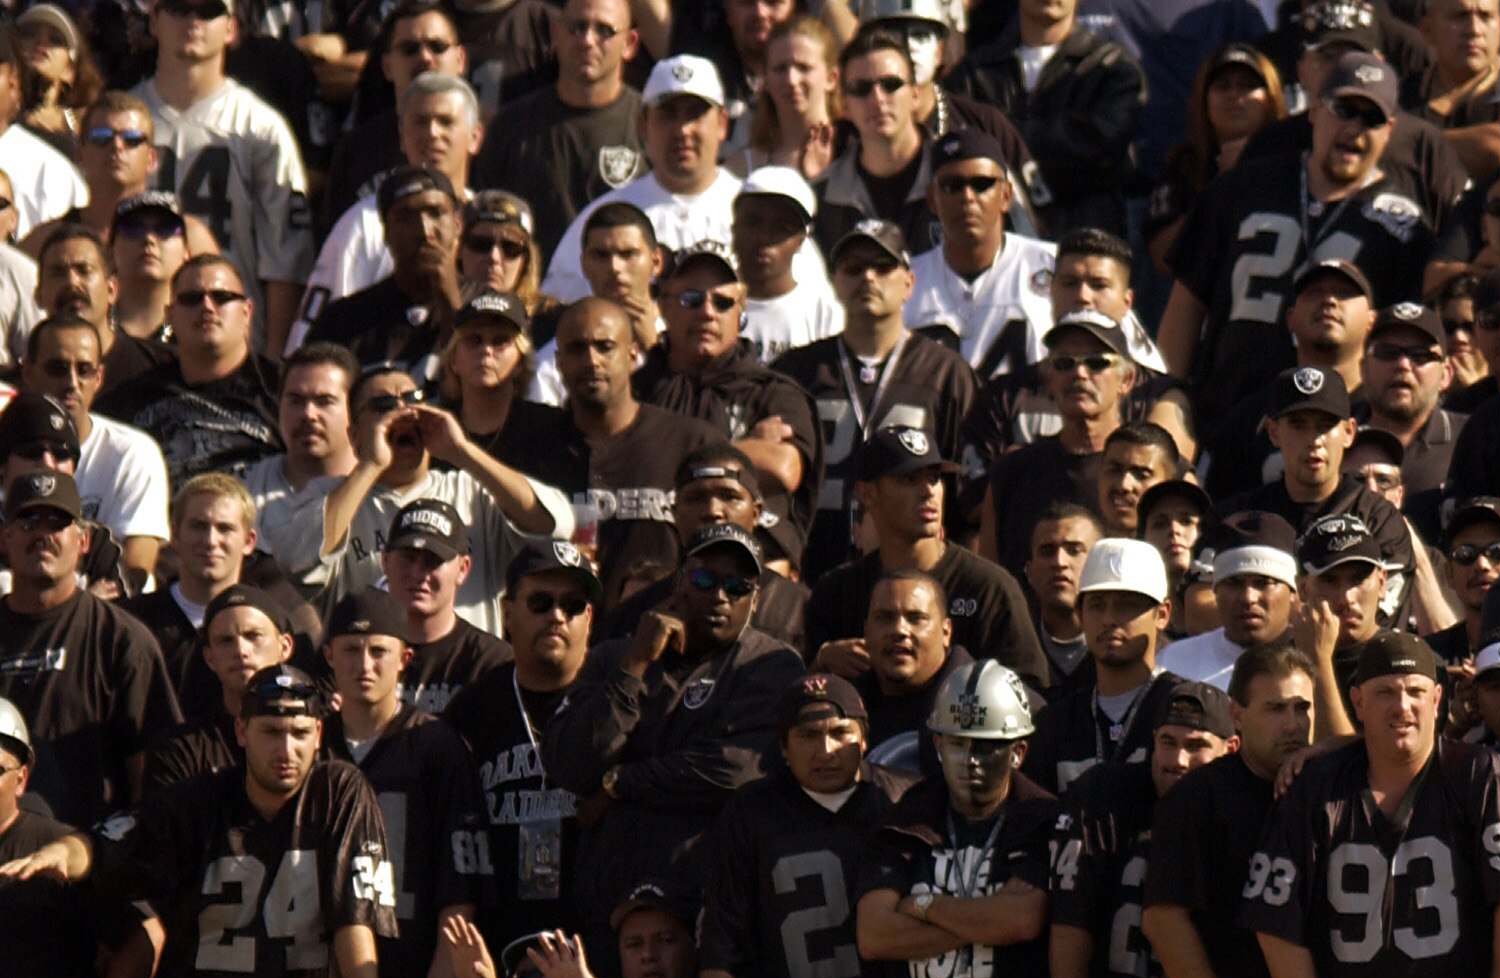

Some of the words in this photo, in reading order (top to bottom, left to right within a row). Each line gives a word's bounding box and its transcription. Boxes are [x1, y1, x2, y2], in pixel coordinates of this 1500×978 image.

[950, 704, 987, 715] BLCK
[953, 715, 984, 726] HLE
[451, 831, 494, 875] 81
[1048, 839, 1082, 891] 4
[352, 856, 396, 907] 24
[1242, 852, 1297, 907] 93
[1326, 836, 1460, 963] 93
[195, 850, 329, 973] 24
